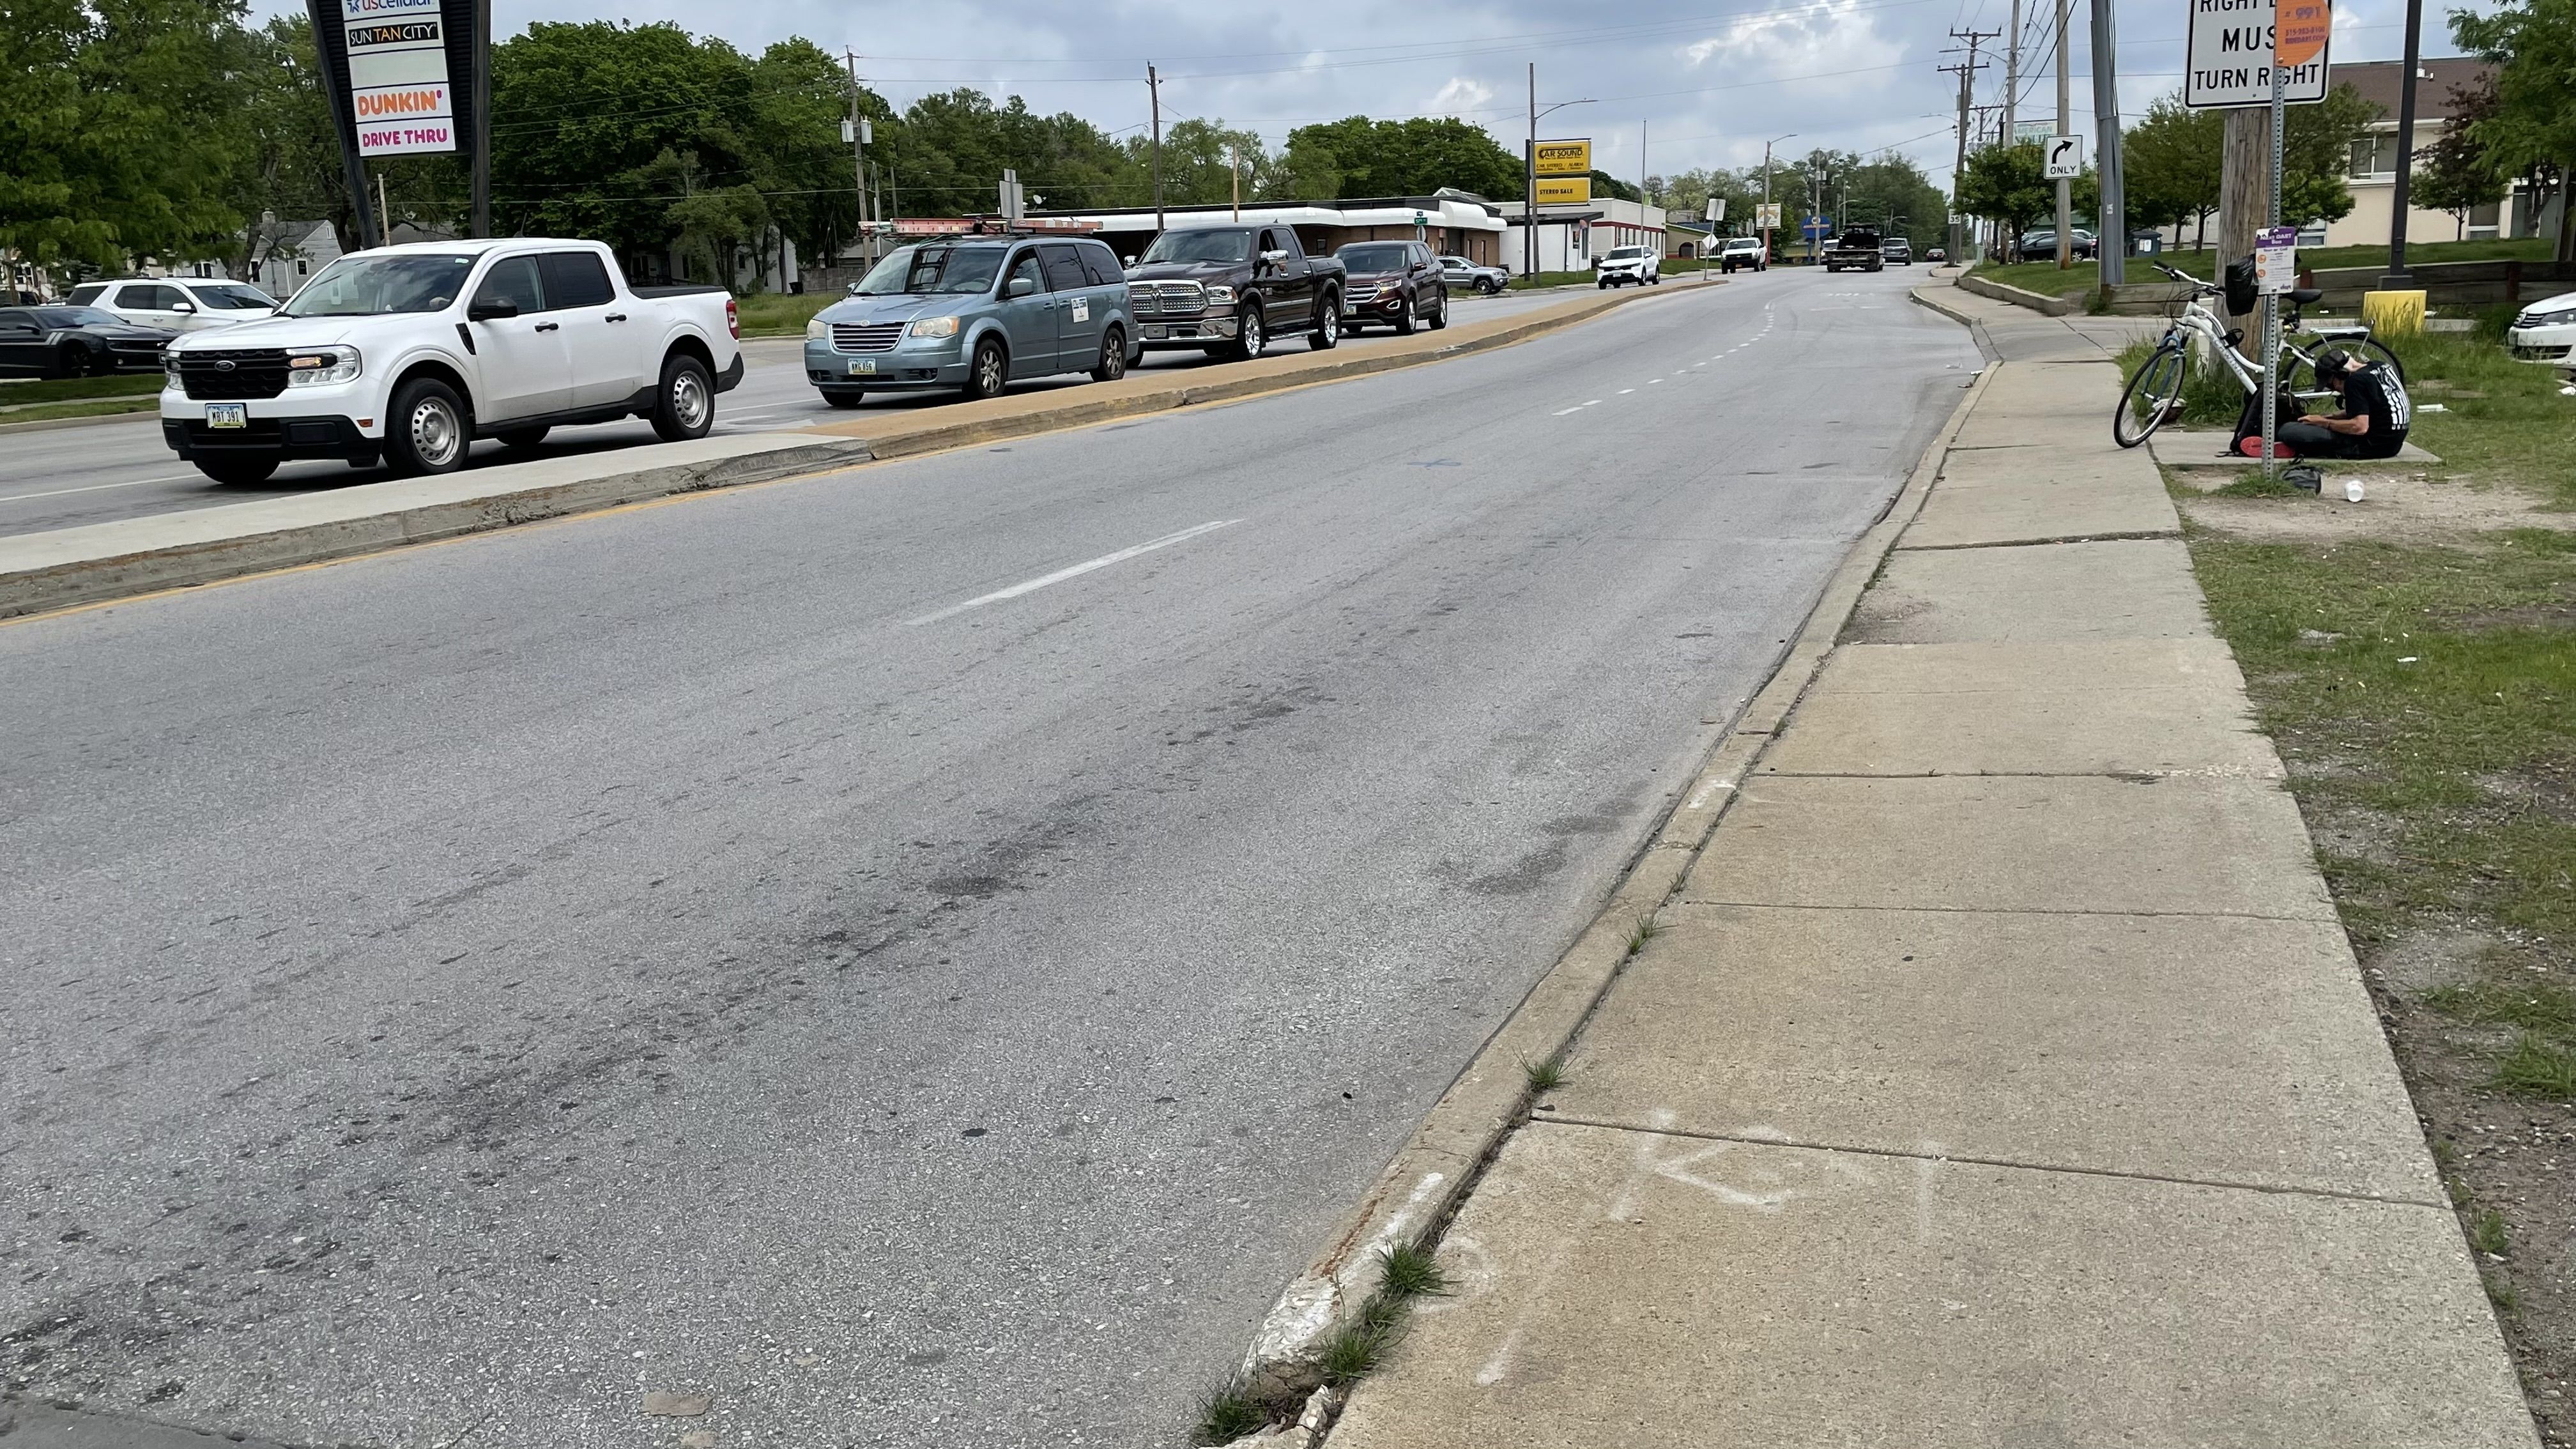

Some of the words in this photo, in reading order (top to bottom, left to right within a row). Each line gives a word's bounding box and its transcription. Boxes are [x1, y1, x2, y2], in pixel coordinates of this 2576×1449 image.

[2296, 6, 2321, 19] 991
[351, 29, 372, 45] SUN
[373, 26, 402, 42] TAN
[2222, 25, 2275, 52] MUS
[2195, 68, 2248, 90] TURN
[2257, 64, 2319, 87] RGHT
[358, 89, 442, 116] DUNKIN'
[362, 130, 401, 148] DRIVE
[404, 128, 448, 144] THRU
[1538, 147, 1556, 160] CAR
[1558, 149, 1583, 157] SOUND
[2050, 165, 2076, 174] ONLY
[227, 411, 240, 422] 391
